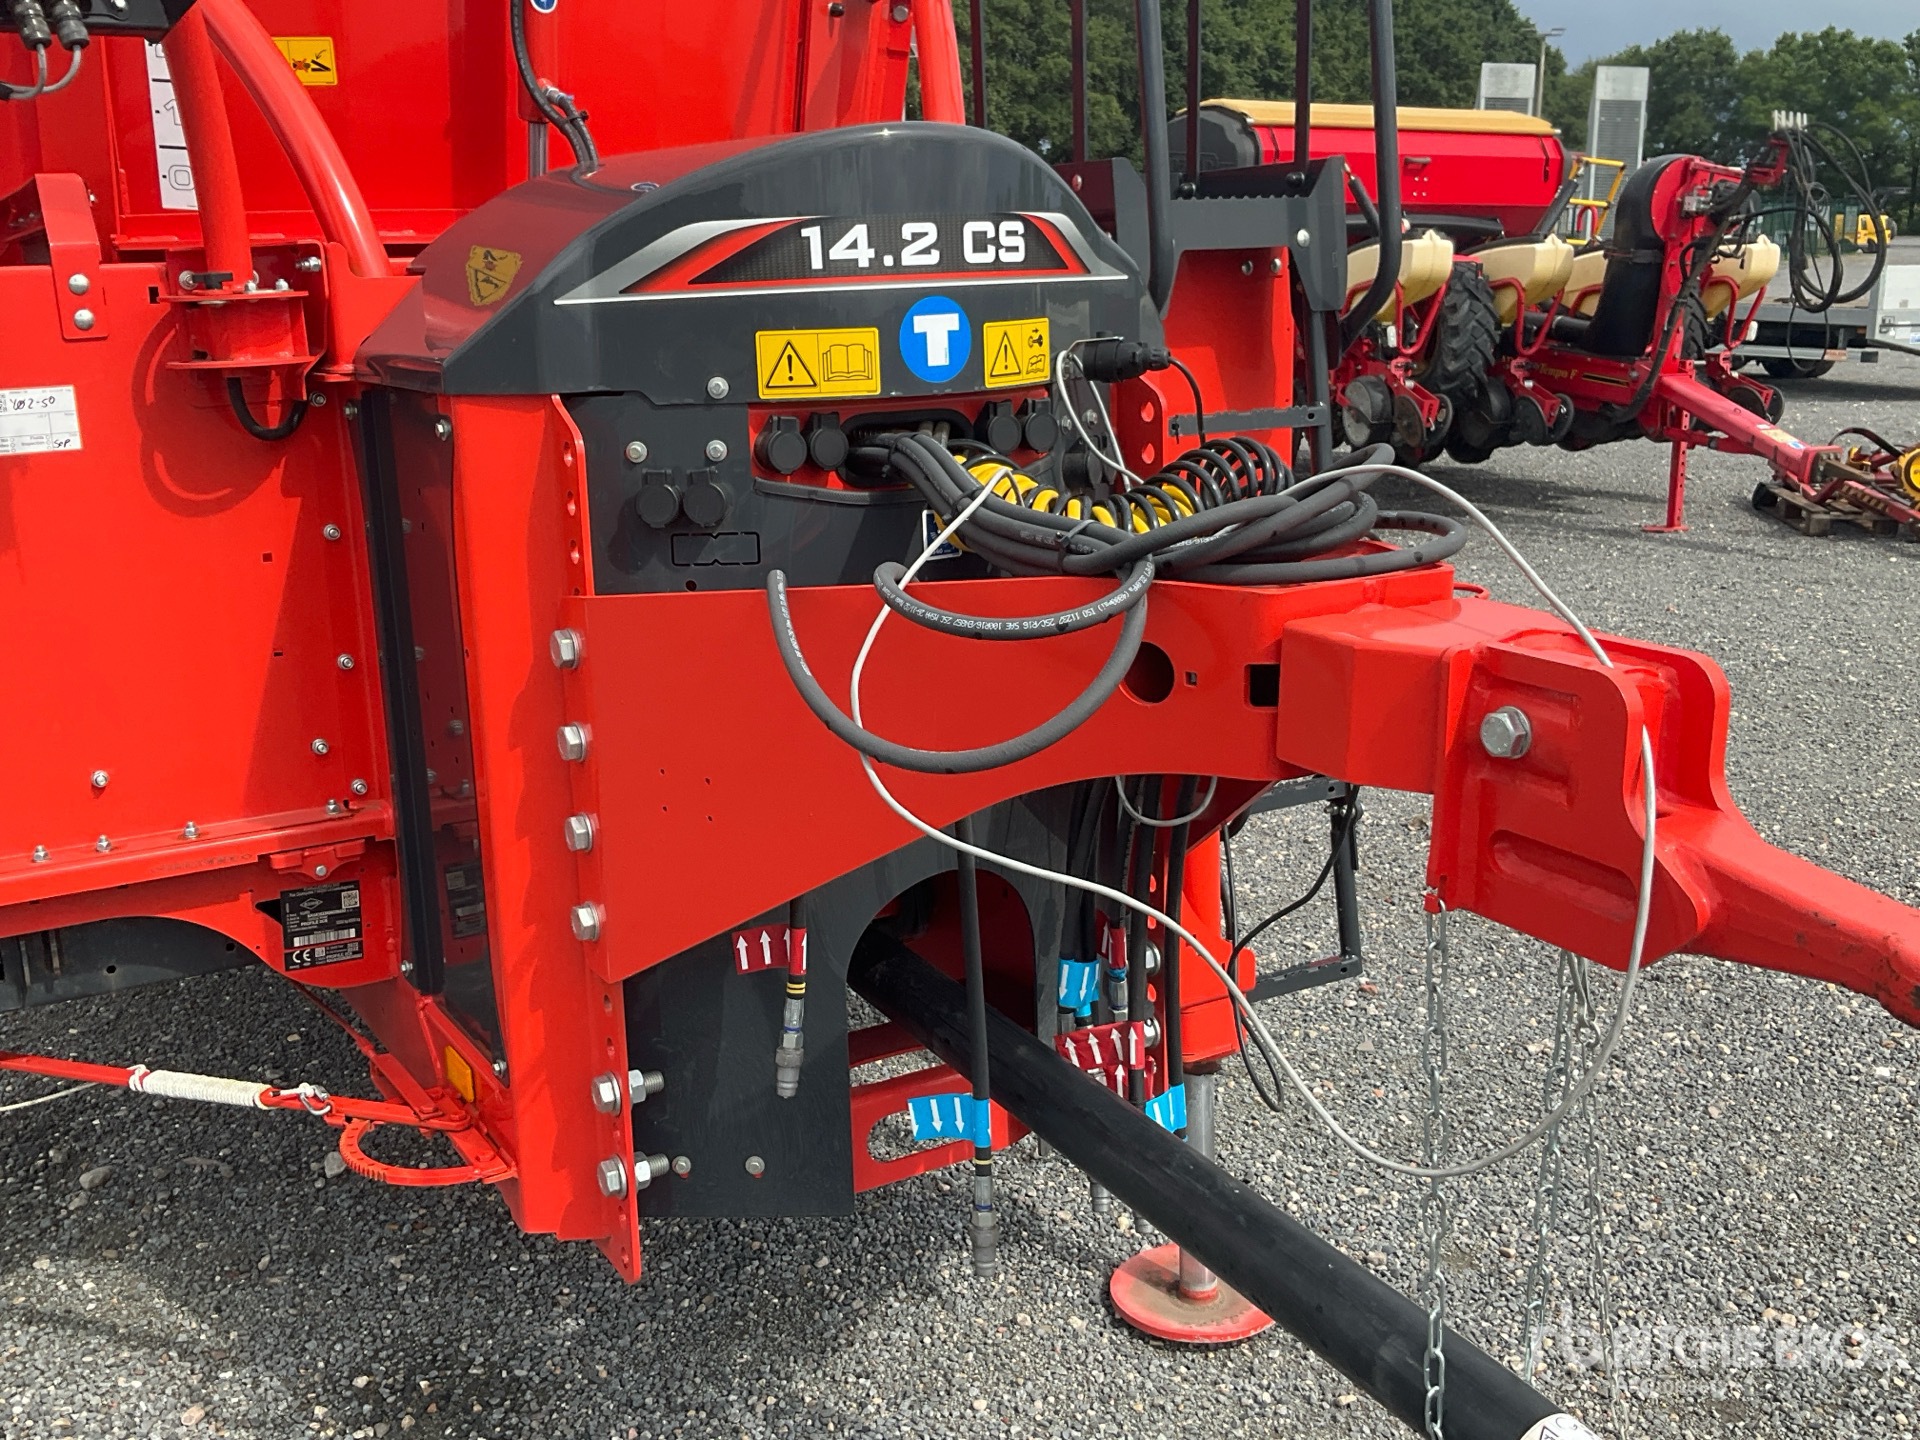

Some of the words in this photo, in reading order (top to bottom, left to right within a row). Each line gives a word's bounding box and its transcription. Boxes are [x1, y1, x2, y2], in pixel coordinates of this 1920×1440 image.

[800, 221, 941, 270] 14.2
[963, 220, 1026, 264] CS
[912, 312, 960, 367] T
[1082, 607, 1096, 618] ISO
[940, 615, 953, 625] 2SC
[1022, 617, 1056, 630] 2SC/R16
[1005, 622, 1020, 631] SAE
